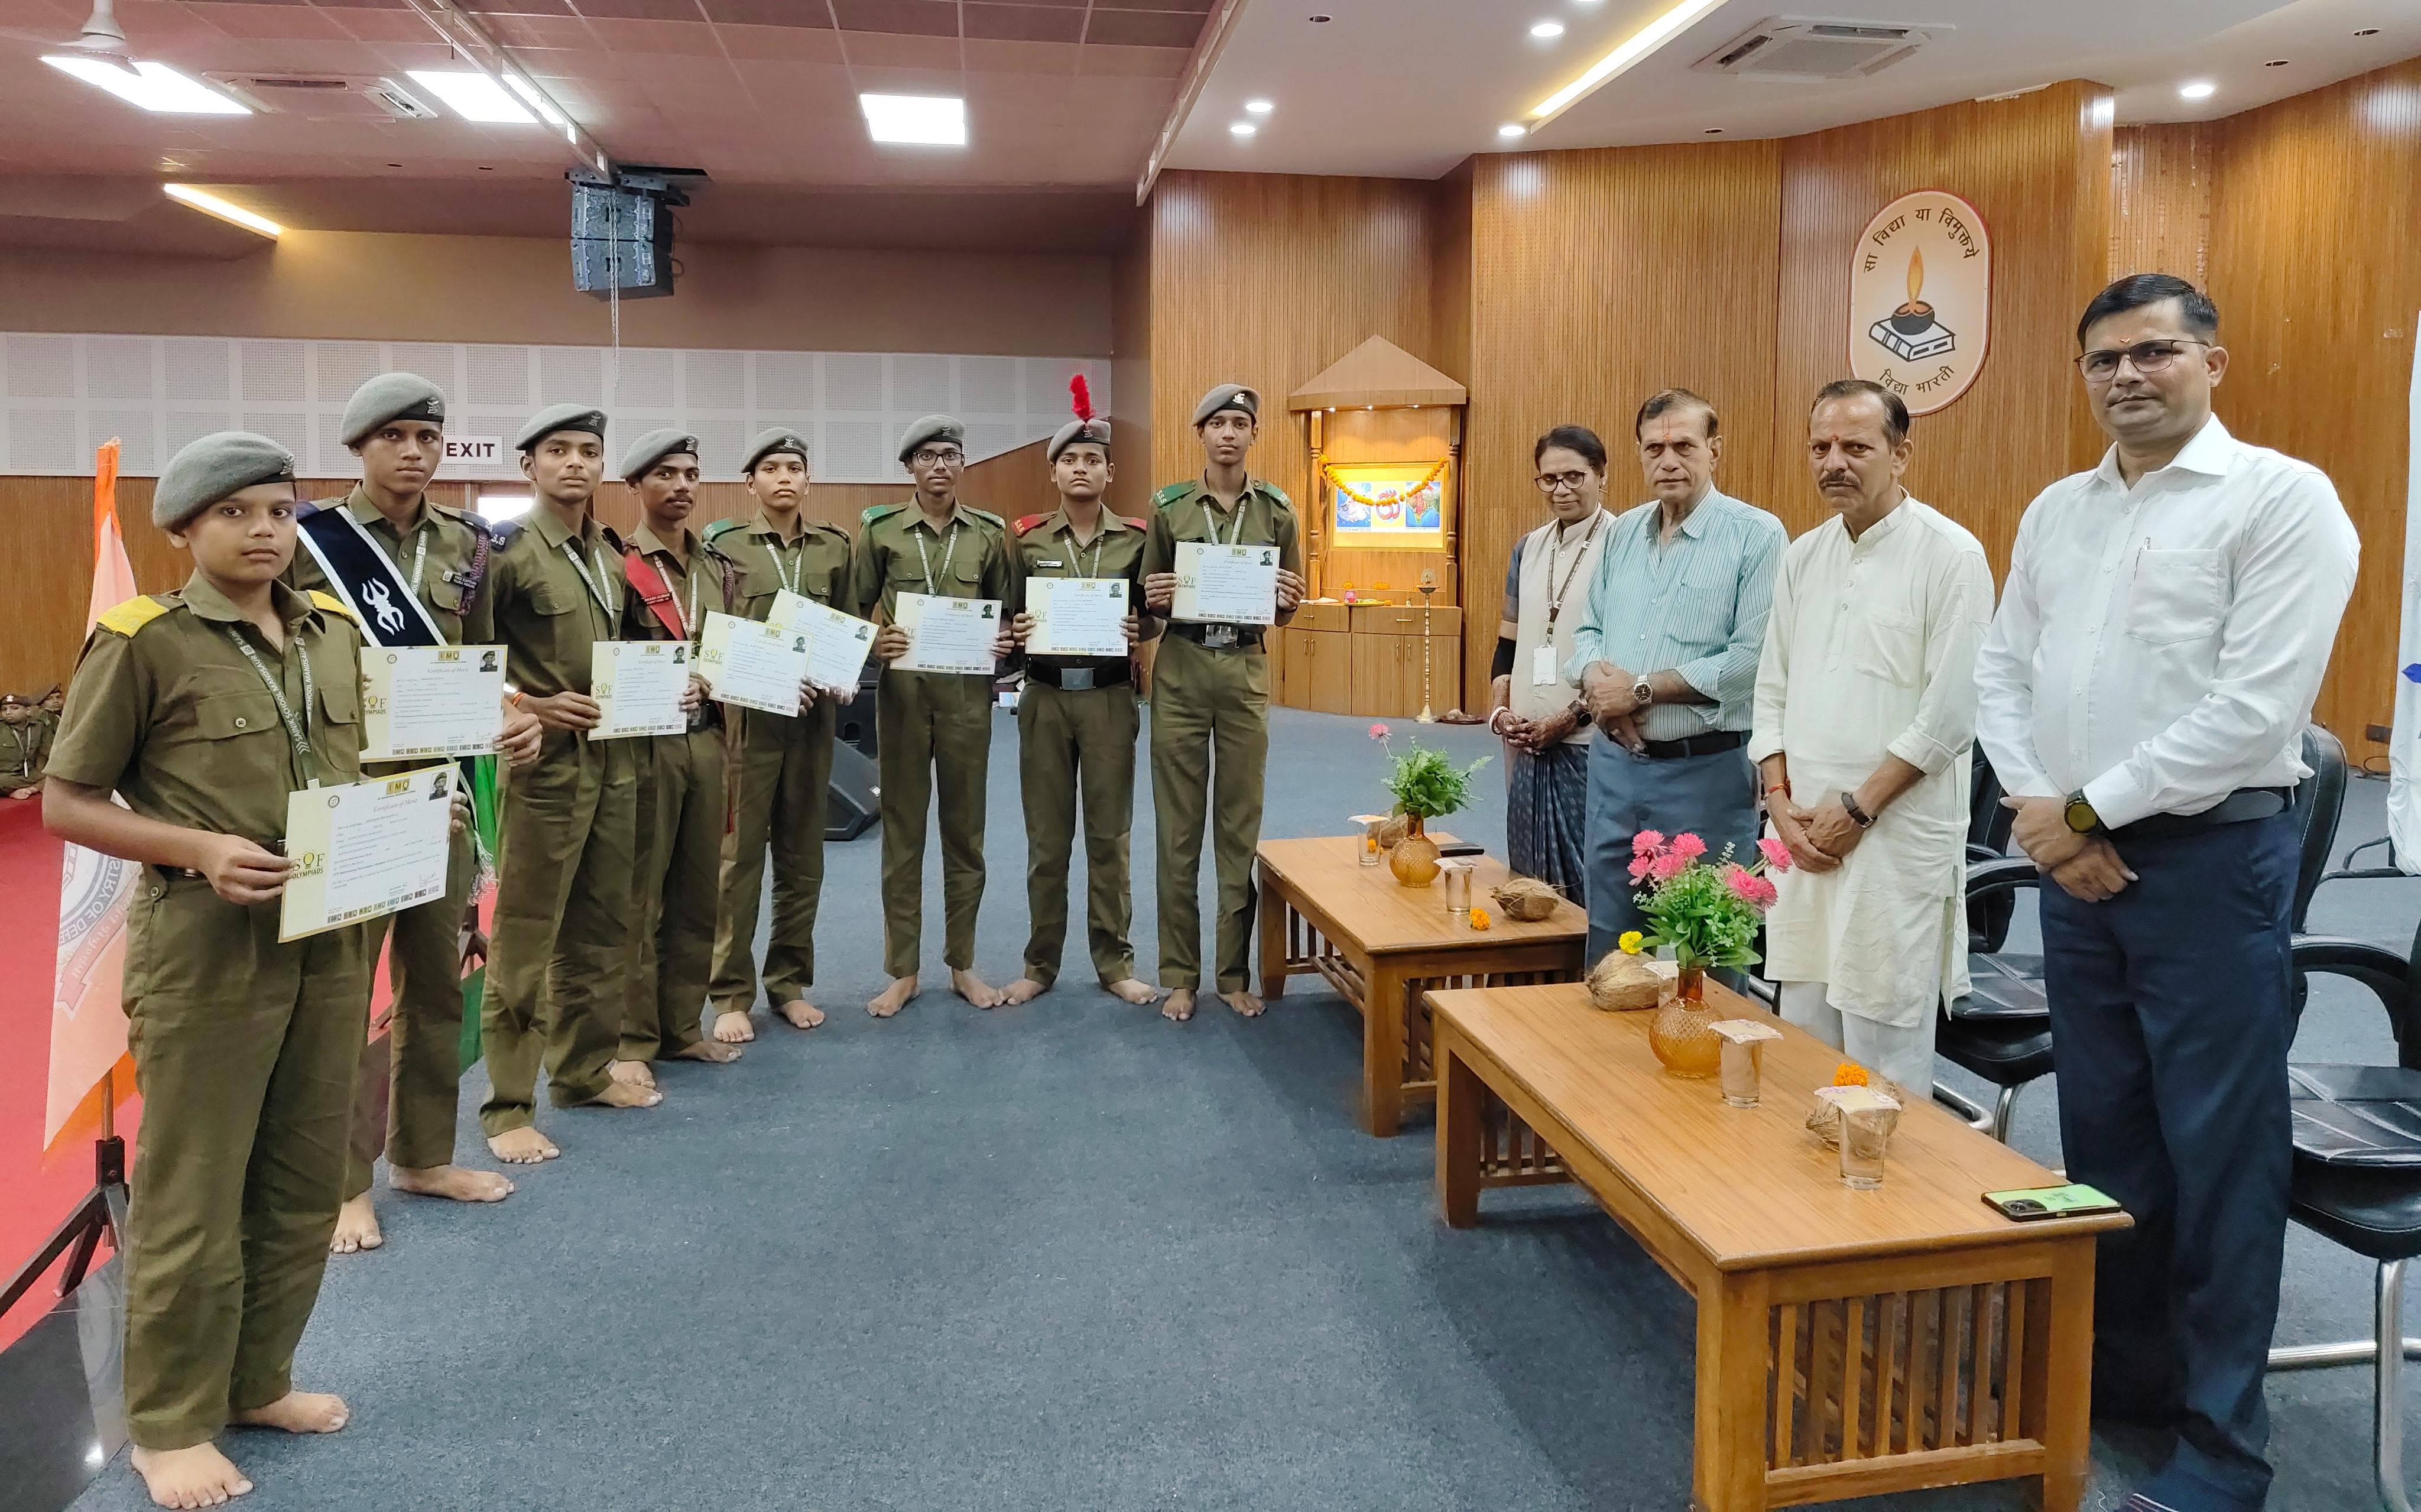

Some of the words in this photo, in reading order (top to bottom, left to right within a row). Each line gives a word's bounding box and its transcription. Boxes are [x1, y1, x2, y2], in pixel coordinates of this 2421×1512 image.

[1864, 252, 1878, 273] सा
[1872, 215, 1906, 246] विद्या
[1914, 208, 1933, 221] या
[1878, 368, 1909, 395] विद्या
[1916, 365, 1955, 393] भारती
[446, 442, 495, 458] EXIT
[299, 647, 312, 683] MANDSAUR
[439, 651, 459, 661] IMO
[250, 652, 280, 693] MANDSAUR
[304, 683, 312, 710] SCHOOL
[596, 683, 613, 694] SOF
[277, 693, 293, 719] SCHOOL
[287, 717, 303, 742] SAINIK
[388, 780, 410, 793] IMO
